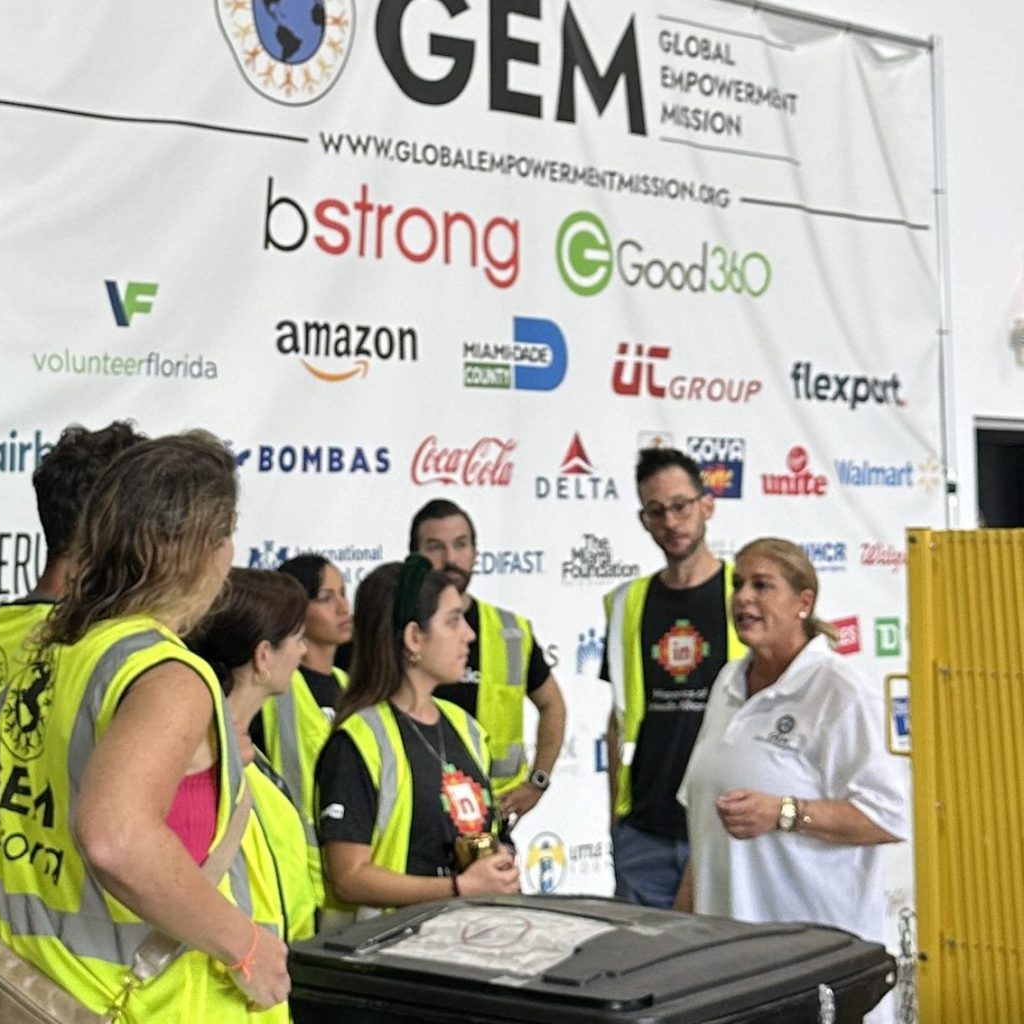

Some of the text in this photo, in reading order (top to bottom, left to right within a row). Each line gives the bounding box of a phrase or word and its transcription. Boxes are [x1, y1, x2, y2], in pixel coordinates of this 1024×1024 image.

[658, 29, 736, 66] GLOBAL
[375, 0, 648, 137] GEM
[660, 65, 799, 116] EMPOWERMENT
[660, 102, 743, 136] MISSION
[319, 131, 731, 208] WWW.GLOBALEMPOWERMENTMISSION.ORG
[264, 177, 520, 288] bstrong
[617, 240, 772, 297] Good360
[275, 319, 419, 361] amazon
[32, 347, 218, 380] volunteerflorida
[668, 374, 763, 403] GROUP
[257, 445, 391, 474] BOMBAS
[834, 457, 914, 487] Walmart
[535, 475, 620, 499] DELTA
[761, 471, 828, 496] unite
